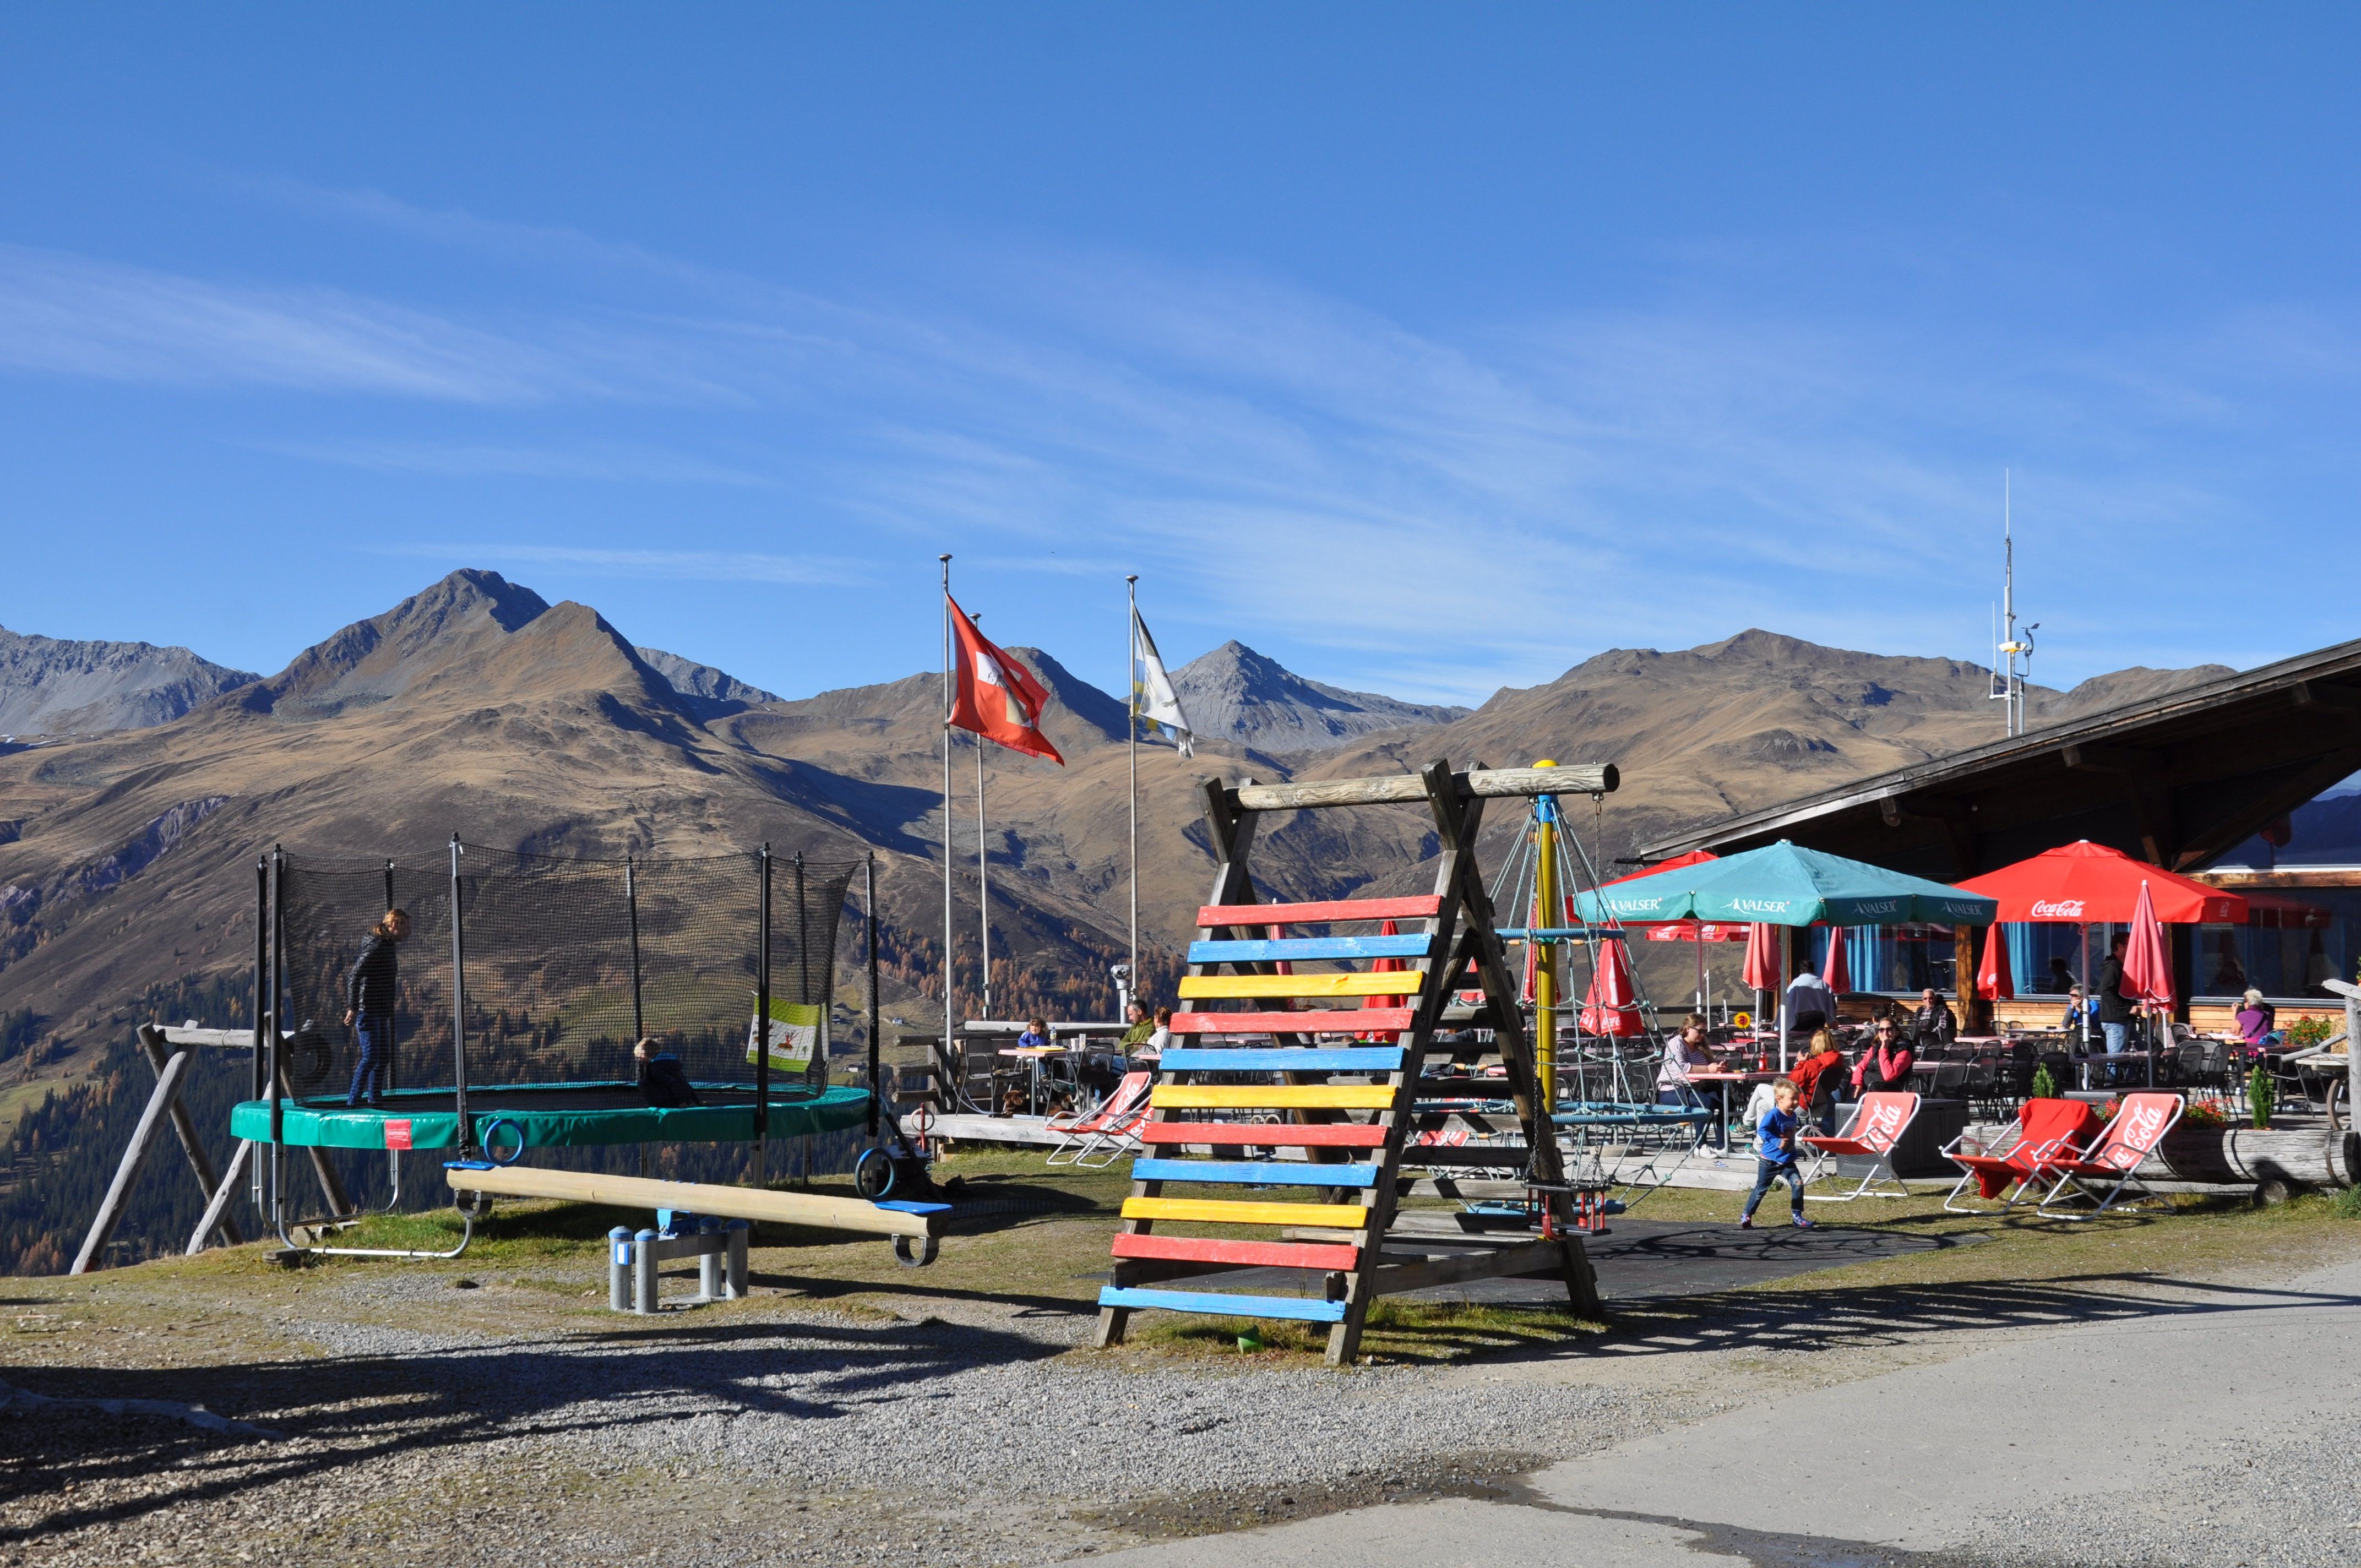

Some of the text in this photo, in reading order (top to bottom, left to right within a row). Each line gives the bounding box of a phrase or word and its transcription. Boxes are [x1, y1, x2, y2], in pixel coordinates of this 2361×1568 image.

[1619, 899, 1660, 911] VALSER
[1742, 899, 1786, 913] VALSER
[1864, 901, 1896, 914] VALSER
[1951, 903, 1982, 916] VALSER
[2031, 900, 2086, 917] Coca-Cola
